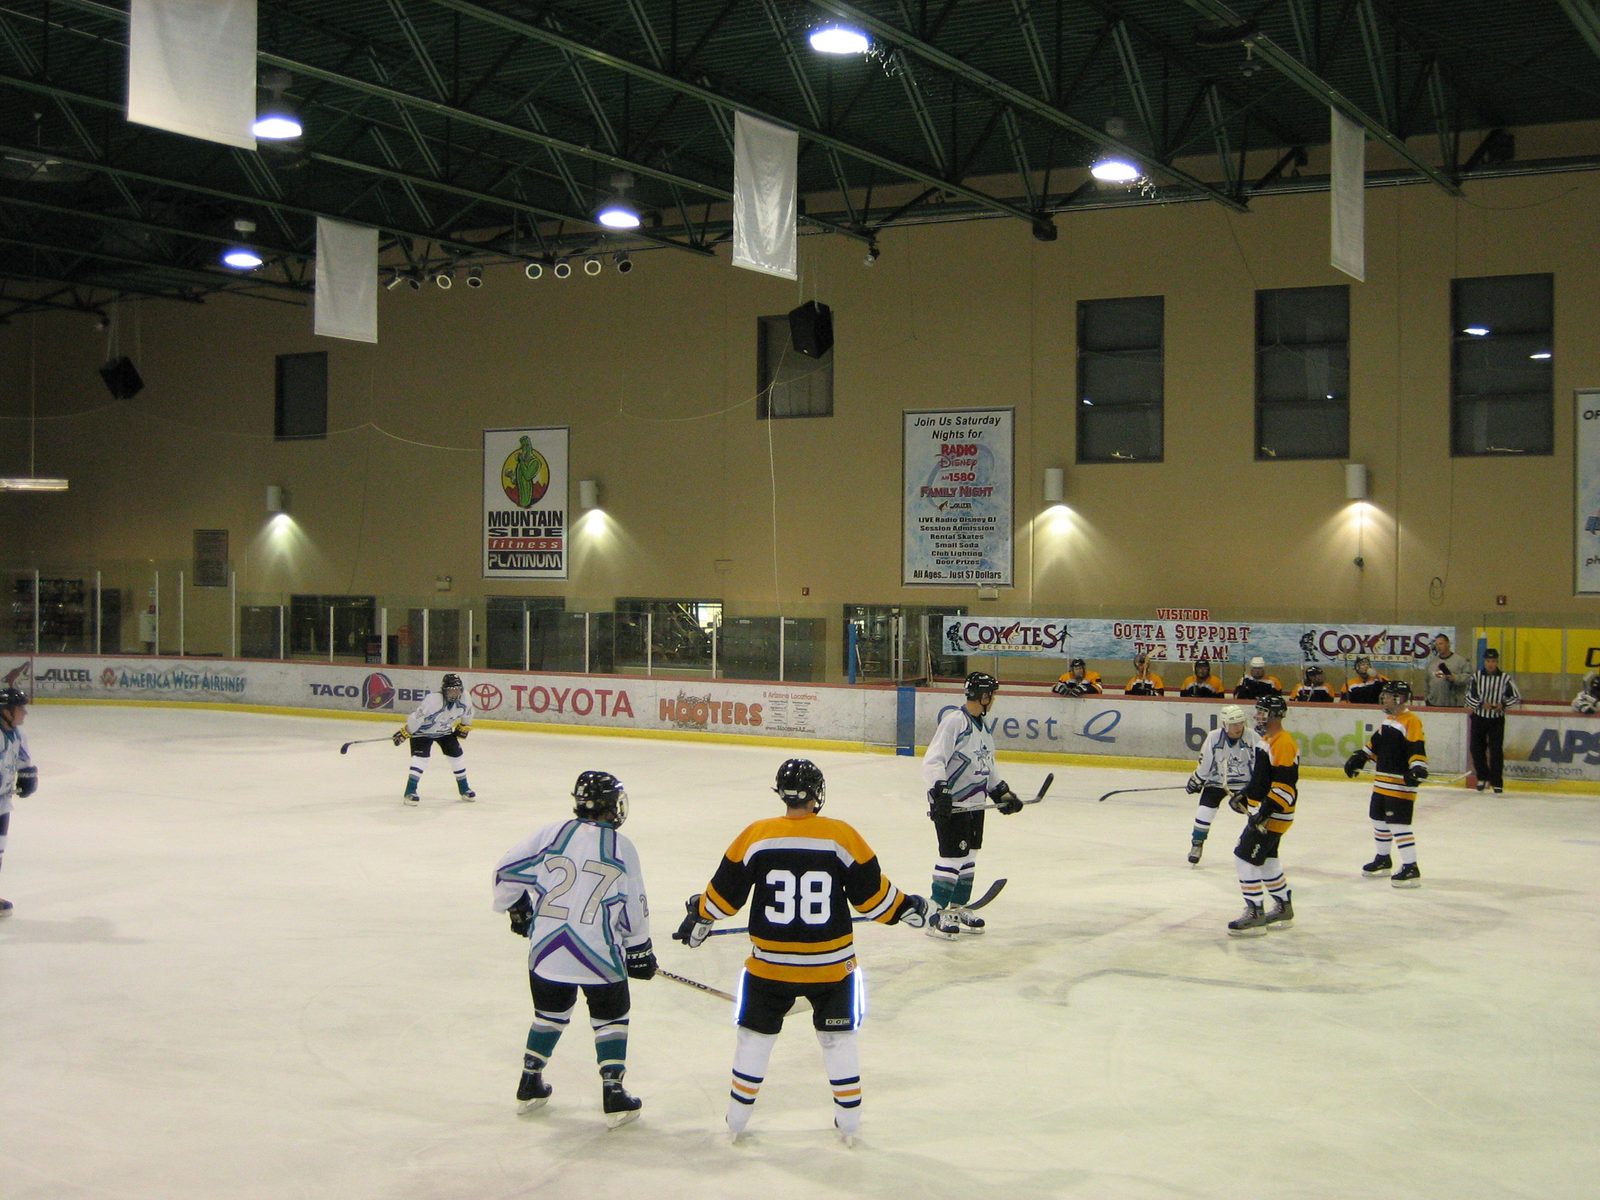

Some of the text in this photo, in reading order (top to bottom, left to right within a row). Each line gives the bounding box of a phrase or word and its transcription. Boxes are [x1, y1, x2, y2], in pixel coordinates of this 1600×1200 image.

[914, 415, 1001, 427] Join Us Saturday
[932, 429, 983, 441] Nights for
[941, 444, 978, 457] RADIO
[949, 472, 976, 482] 1580
[920, 486, 994, 498] FAMILY NIGHT
[488, 510, 563, 527] MOUNTAIN
[488, 527, 563, 538] SIDE
[491, 539, 559, 549] fitness
[488, 553, 562, 568] PLATINUM
[950, 550, 983, 558] Lighting
[913, 570, 923, 578] All
[949, 570, 964, 579] Just
[965, 570, 974, 579] $7
[975, 570, 1002, 579] Dollars
[1156, 608, 1209, 620] VISITOR
[1113, 622, 1250, 642] GOTTA SUPPORT
[1176, 643, 1229, 661] TEAM!
[34, 668, 92, 681] ALLTEL
[119, 670, 246, 692] AMERICA WEST AIRLINES
[309, 683, 431, 701] TACO BE
[510, 684, 635, 719] TOYOTA
[659, 698, 763, 726] HOOTERS
[1528, 728, 1600, 765] APS
[537, 855, 623, 925] 27
[764, 869, 832, 925] 38
